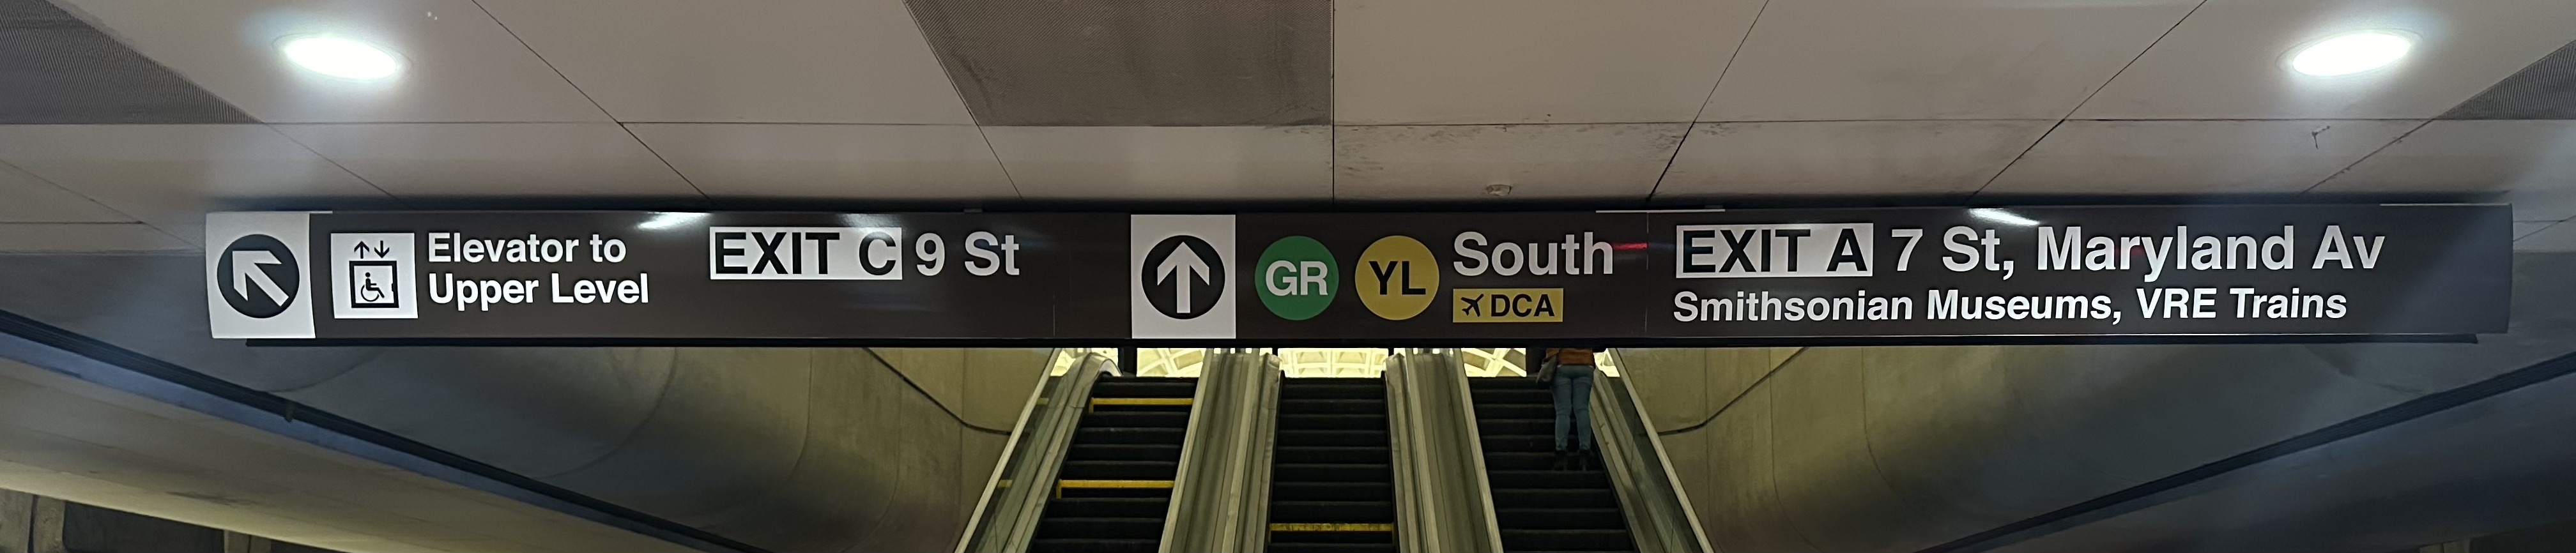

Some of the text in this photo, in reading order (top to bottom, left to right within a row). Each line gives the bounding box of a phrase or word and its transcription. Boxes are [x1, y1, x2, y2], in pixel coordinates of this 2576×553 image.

[428, 232, 626, 264] Elevator to
[715, 231, 1020, 276] EXIT C 9 St
[1453, 231, 1614, 277] South
[1682, 224, 2386, 283] EXIT A 7 St, Maryland Av
[428, 273, 648, 312] Upper Level
[1265, 260, 1329, 297] GR
[1368, 261, 1426, 296] YL
[1490, 294, 1555, 318] DCA
[1673, 288, 2347, 325] Smithsonian Museums, VRE Trains
